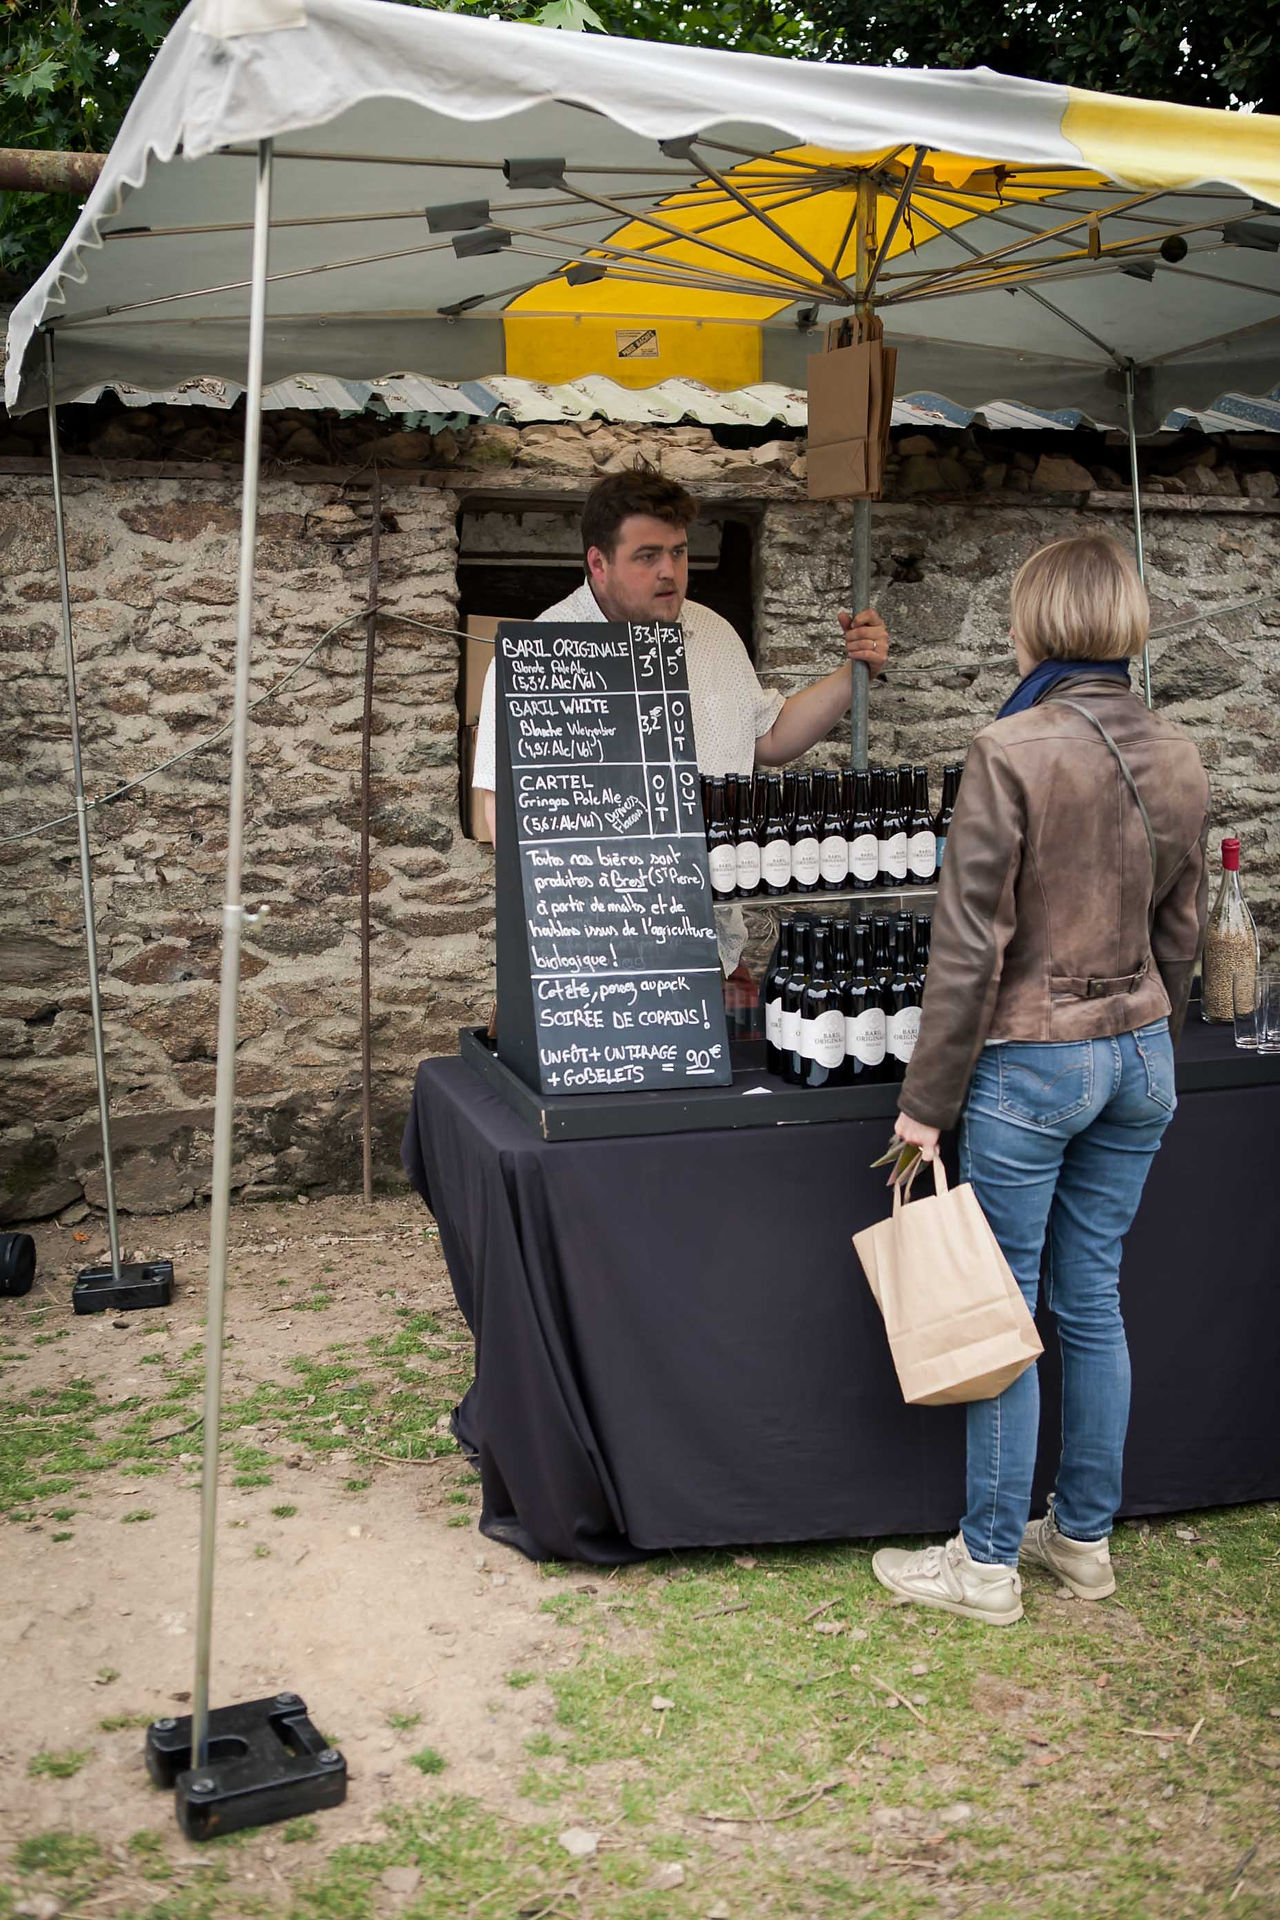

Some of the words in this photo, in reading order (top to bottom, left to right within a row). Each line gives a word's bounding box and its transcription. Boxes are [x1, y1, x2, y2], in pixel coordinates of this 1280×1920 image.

[502, 637, 551, 657] BARIL
[552, 638, 630, 658] ORIGINALE
[512, 660, 545, 673] Blonde
[510, 699, 559, 717] BARIL
[560, 698, 610, 715] WHITE
[519, 718, 563, 737] Blanche
[519, 775, 594, 791] CARTEL
[518, 792, 570, 812] Gringos
[526, 850, 564, 866] Toutes
[570, 854, 594, 866] nos
[597, 846, 644, 866] bières
[650, 844, 681, 864] sont
[534, 869, 594, 893] produites
[599, 872, 610, 887] à
[610, 869, 648, 888] Brest
[536, 900, 549, 915] à
[551, 894, 585, 918] partir
[590, 896, 606, 912] de
[607, 893, 646, 914] malts
[651, 893, 668, 914] et
[670, 896, 686, 913] de
[528, 919, 581, 938] houblons
[583, 924, 619, 938] issus
[622, 919, 639, 936] de
[641, 915, 717, 944] l'agriculture
[657, 976, 690, 997] pack
[539, 1003, 605, 1028] SOIRÉE
[612, 1010, 634, 1029] DE
[540, 1048, 561, 1066] UN
[604, 1046, 625, 1062] UN
[624, 1045, 678, 1060] TIRAGE
